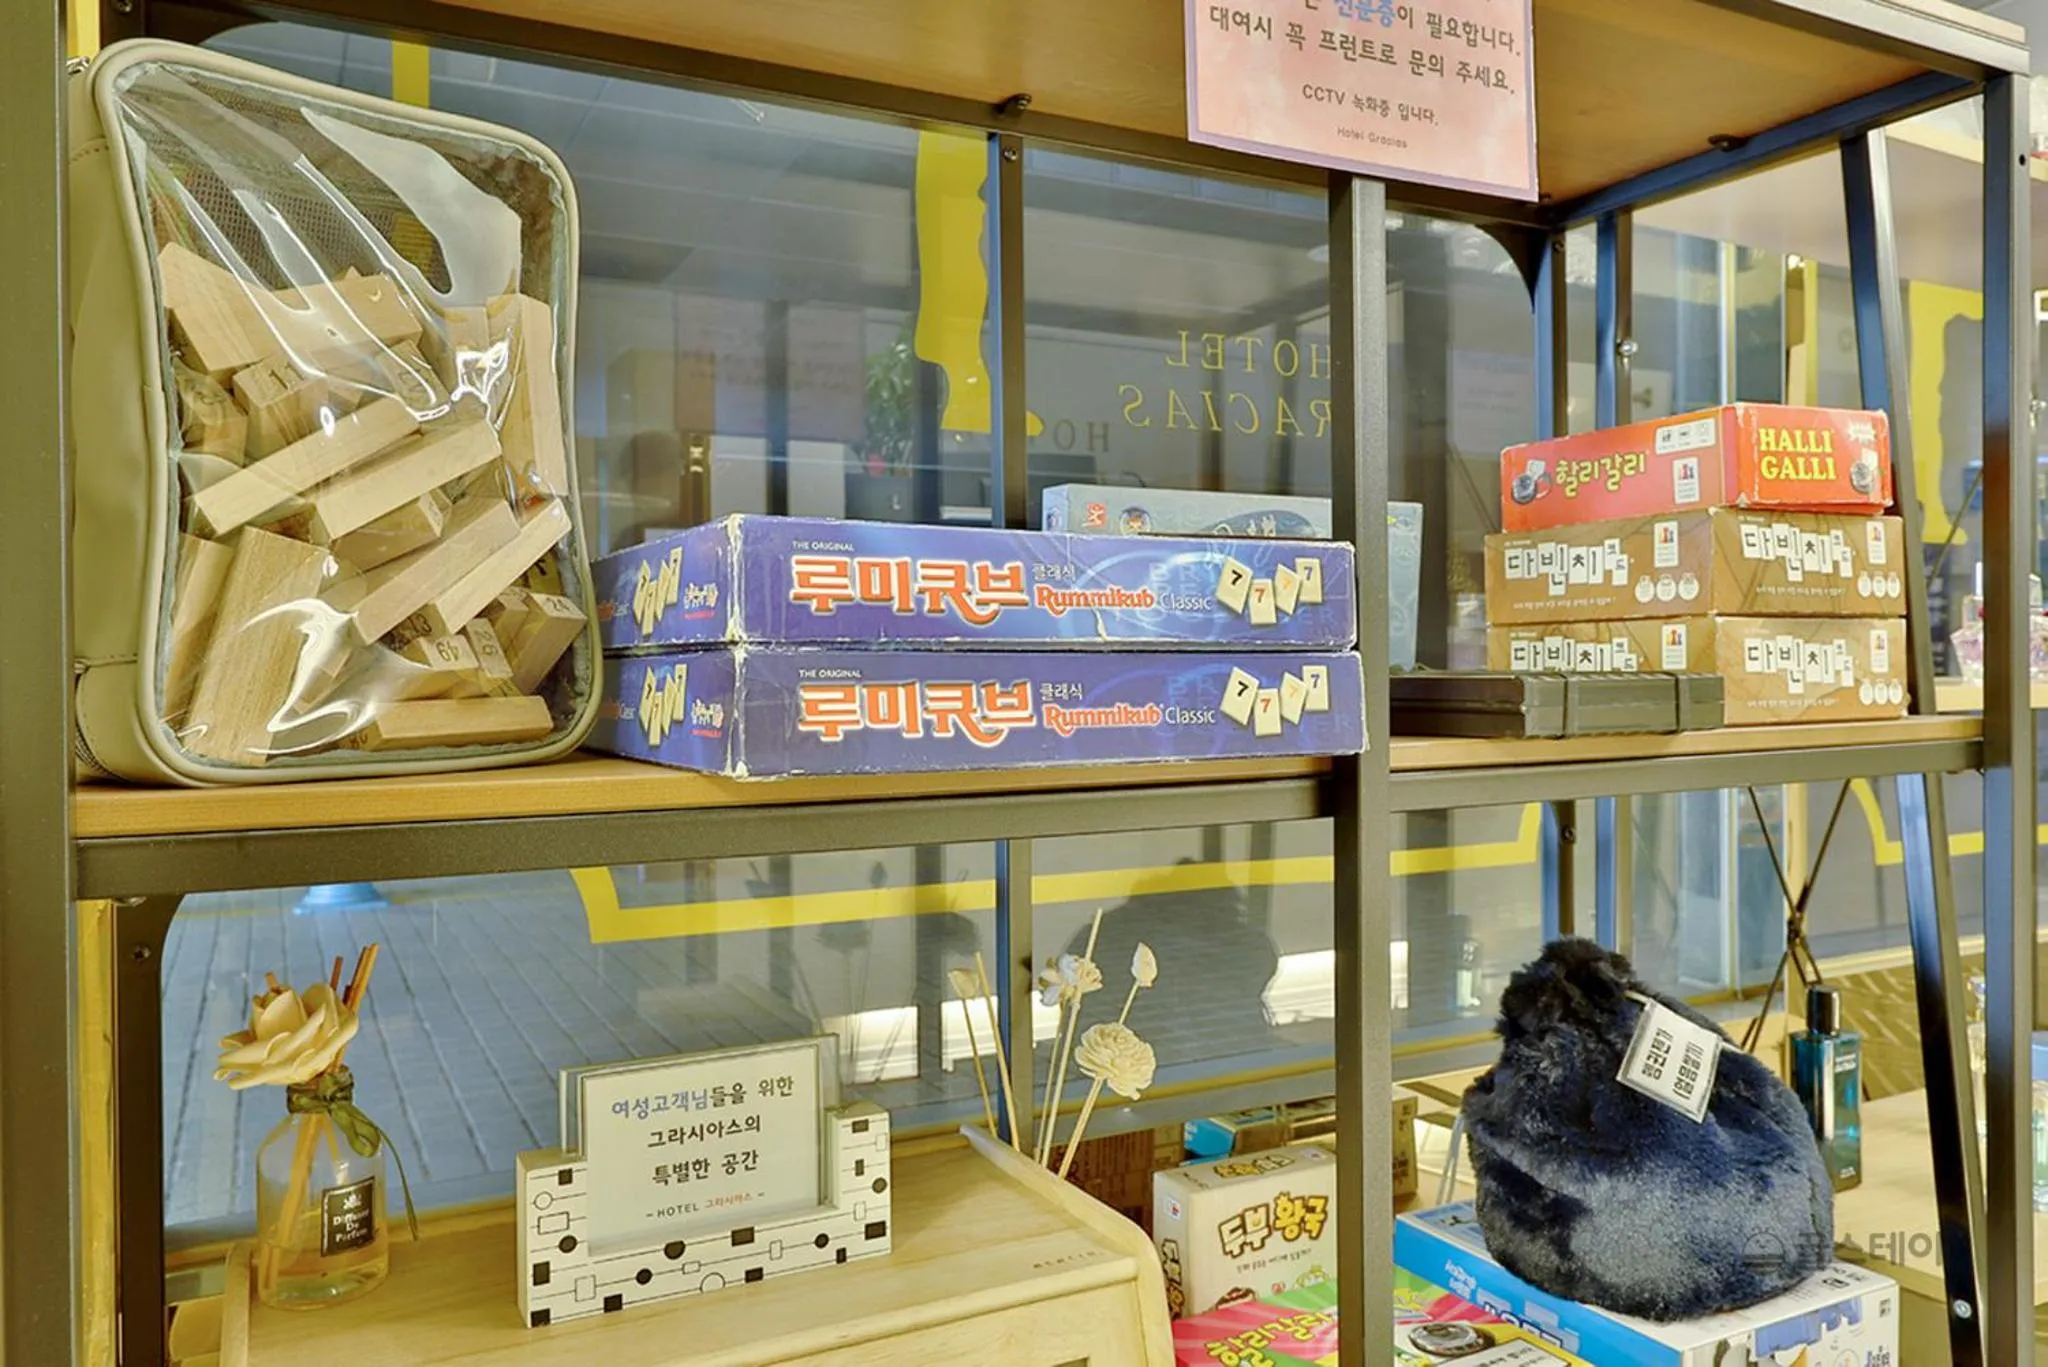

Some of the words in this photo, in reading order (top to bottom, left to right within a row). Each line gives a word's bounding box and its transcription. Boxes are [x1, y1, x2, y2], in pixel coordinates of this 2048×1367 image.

[1210, 6, 1273, 39] 대여시
[1286, 22, 1306, 51] 꼭
[1319, 30, 1398, 67] 프런트로
[1409, 49, 1445, 78] 문의
[1456, 60, 1515, 95] 주세요.
[1425, 12, 1521, 57] 필요합니다.
[1302, 84, 1346, 105] CCTV
[1352, 94, 1391, 118] 녹화중
[1398, 103, 1439, 126] 입니다.
[1337, 127, 1364, 141] Hotel
[1758, 428, 1833, 454] HALLI
[1555, 453, 1646, 498] 할리갈리
[1760, 455, 1837, 481] GALLI
[792, 540, 810, 550] THE
[811, 541, 856, 551] ORIGINAL
[1032, 564, 1076, 582] 클래식
[1230, 569, 1243, 586] 7
[1255, 587, 1266, 602] 7
[1304, 566, 1313, 581] 7
[790, 555, 1028, 627] 루미큐브
[1035, 584, 1156, 617] Rummikub
[1160, 592, 1213, 612] Classic
[799, 669, 817, 678] THE
[819, 669, 862, 678] ORIGINAL
[1040, 683, 1083, 700] 클래식
[1237, 681, 1249, 697] 7
[1260, 698, 1272, 713] 7
[1310, 673, 1320, 689] 7
[799, 680, 1036, 747] 루미큐브
[1042, 702, 1162, 737] Rummikub
[1165, 705, 1216, 724] Classic
[611, 1082, 747, 1120] 여성고객님들을
[758, 1075, 794, 1097] 위한
[647, 1115, 761, 1148] 그라시아스의
[652, 1158, 711, 1186] 특별한
[721, 1149, 759, 1176] 공간
[657, 1203, 700, 1218] HOTEL
[1205, 1311, 1332, 1367] 할리갈리
